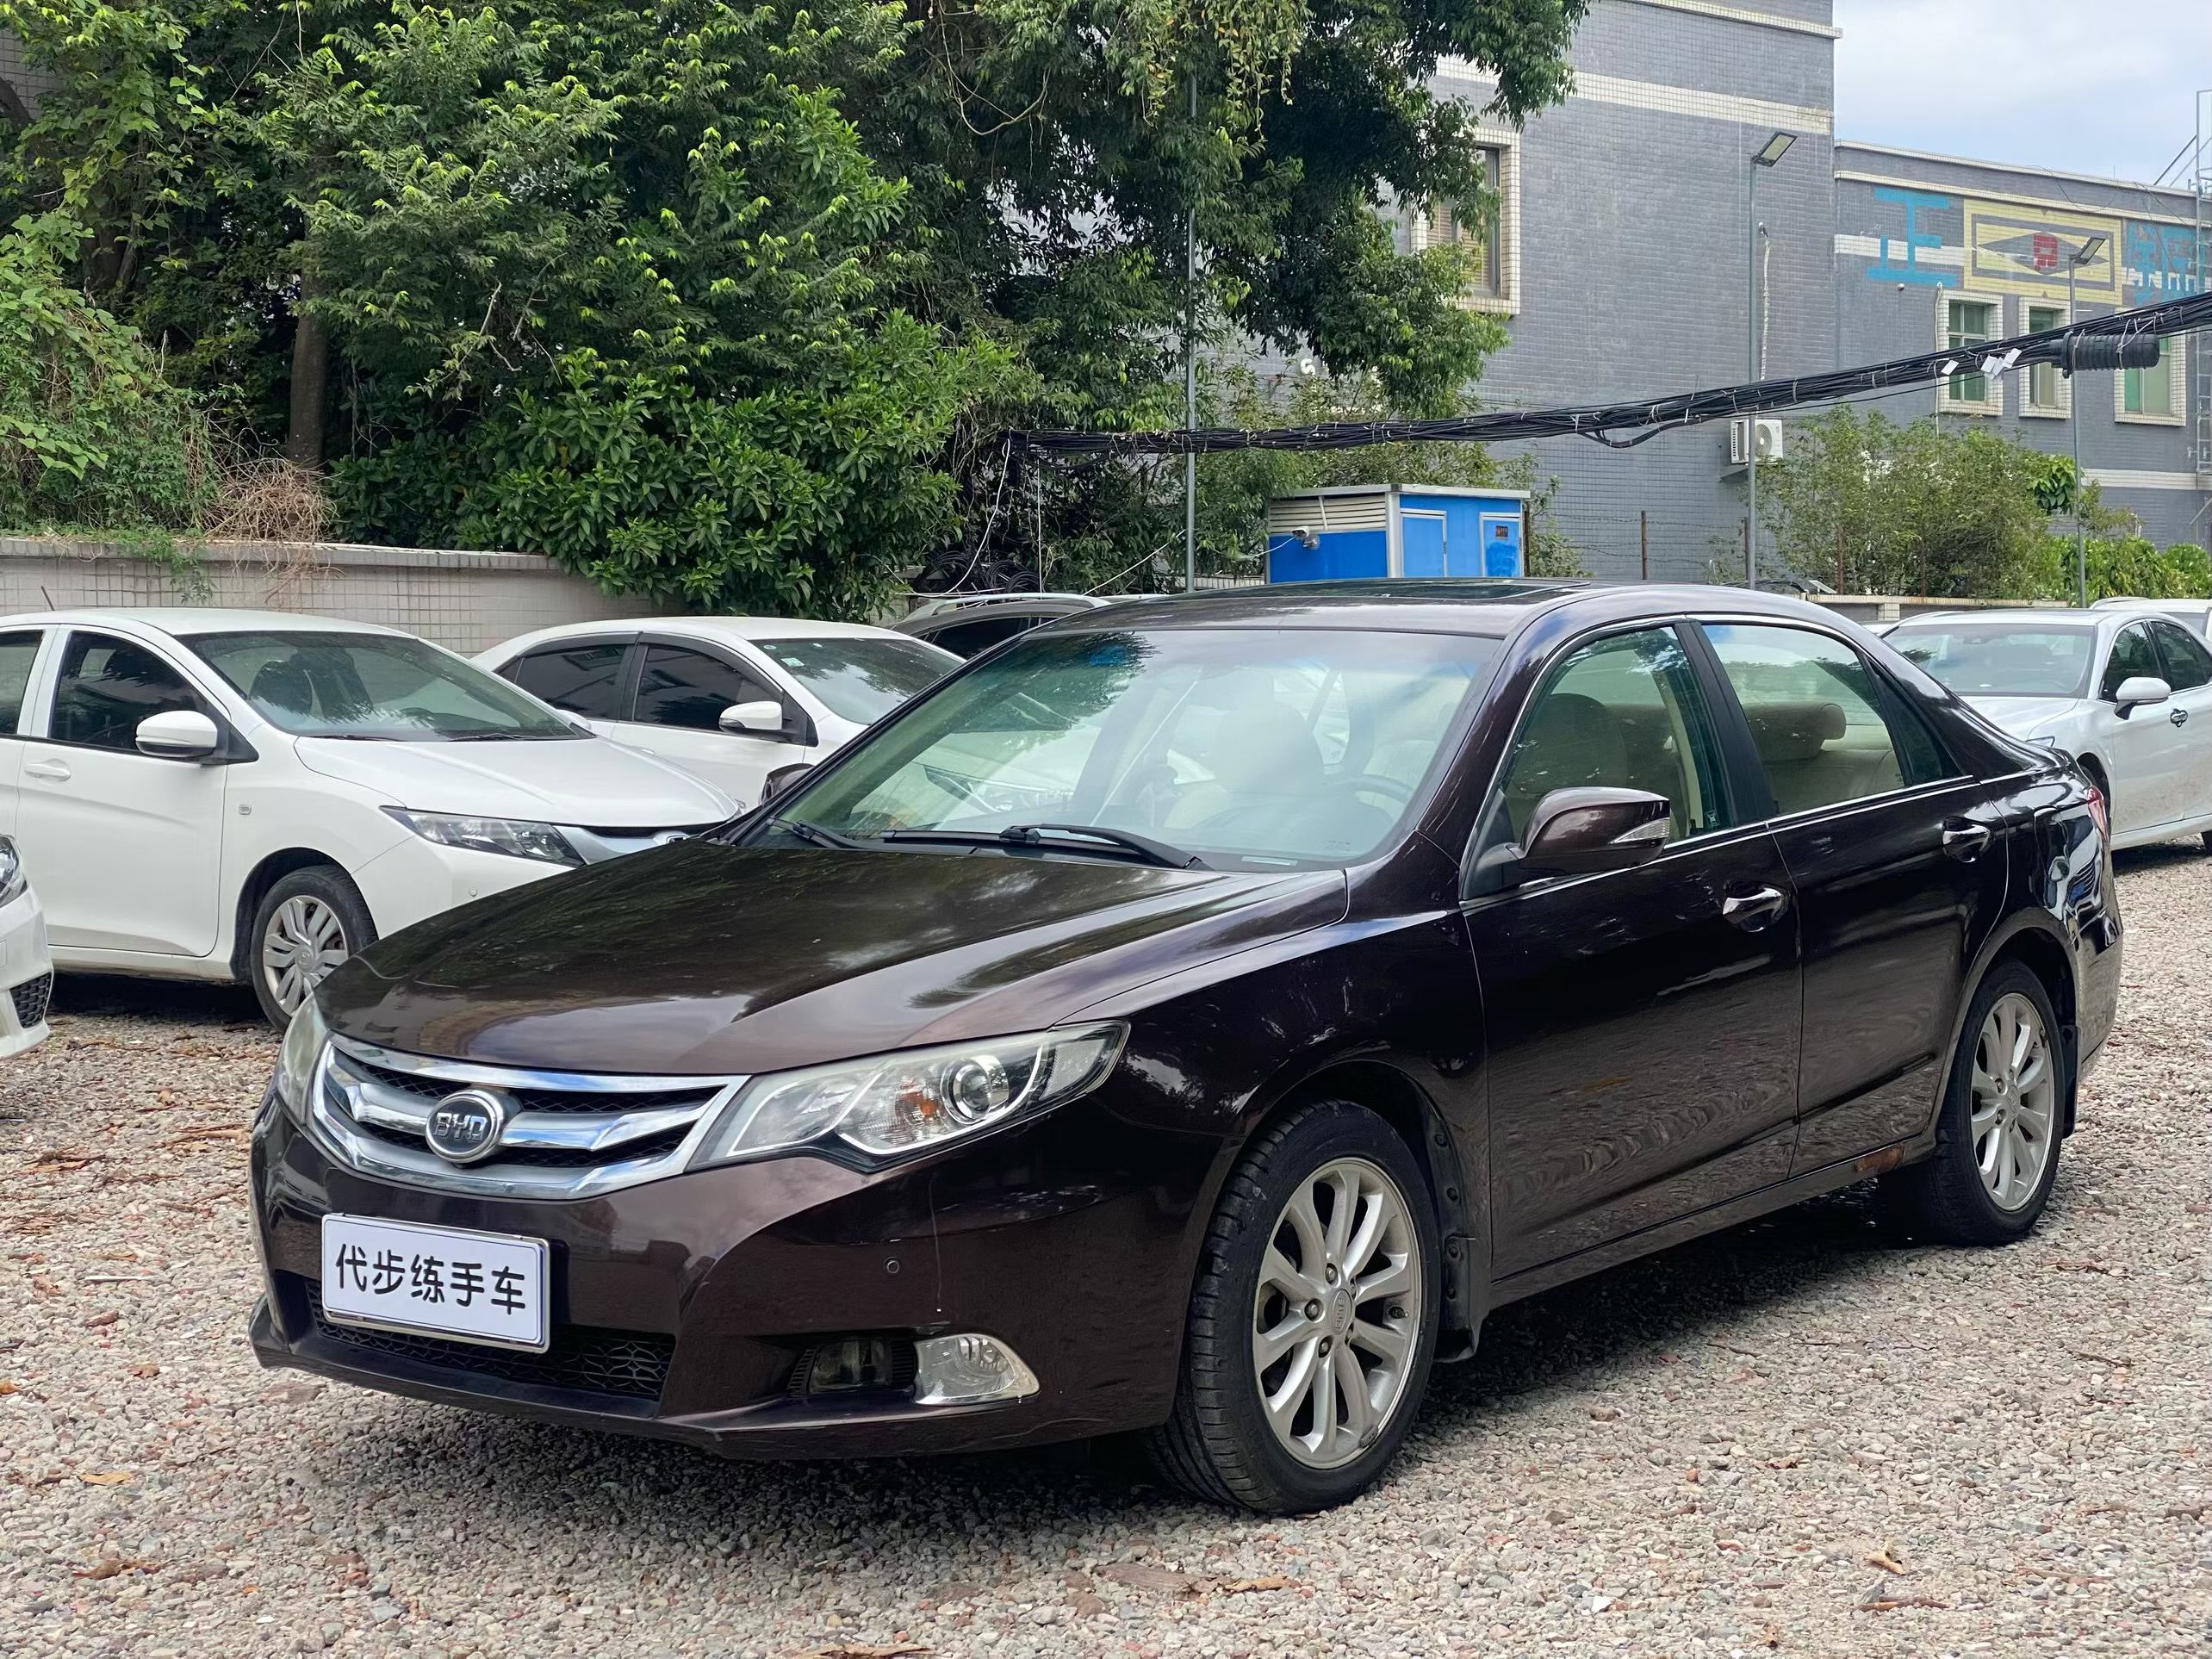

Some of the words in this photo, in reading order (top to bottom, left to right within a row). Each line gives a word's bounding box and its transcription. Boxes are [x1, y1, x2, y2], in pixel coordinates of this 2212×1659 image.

[1866, 186, 1957, 288] 正
[433, 1112, 488, 1141] BYD
[335, 1243, 526, 1315] 代步练手车
